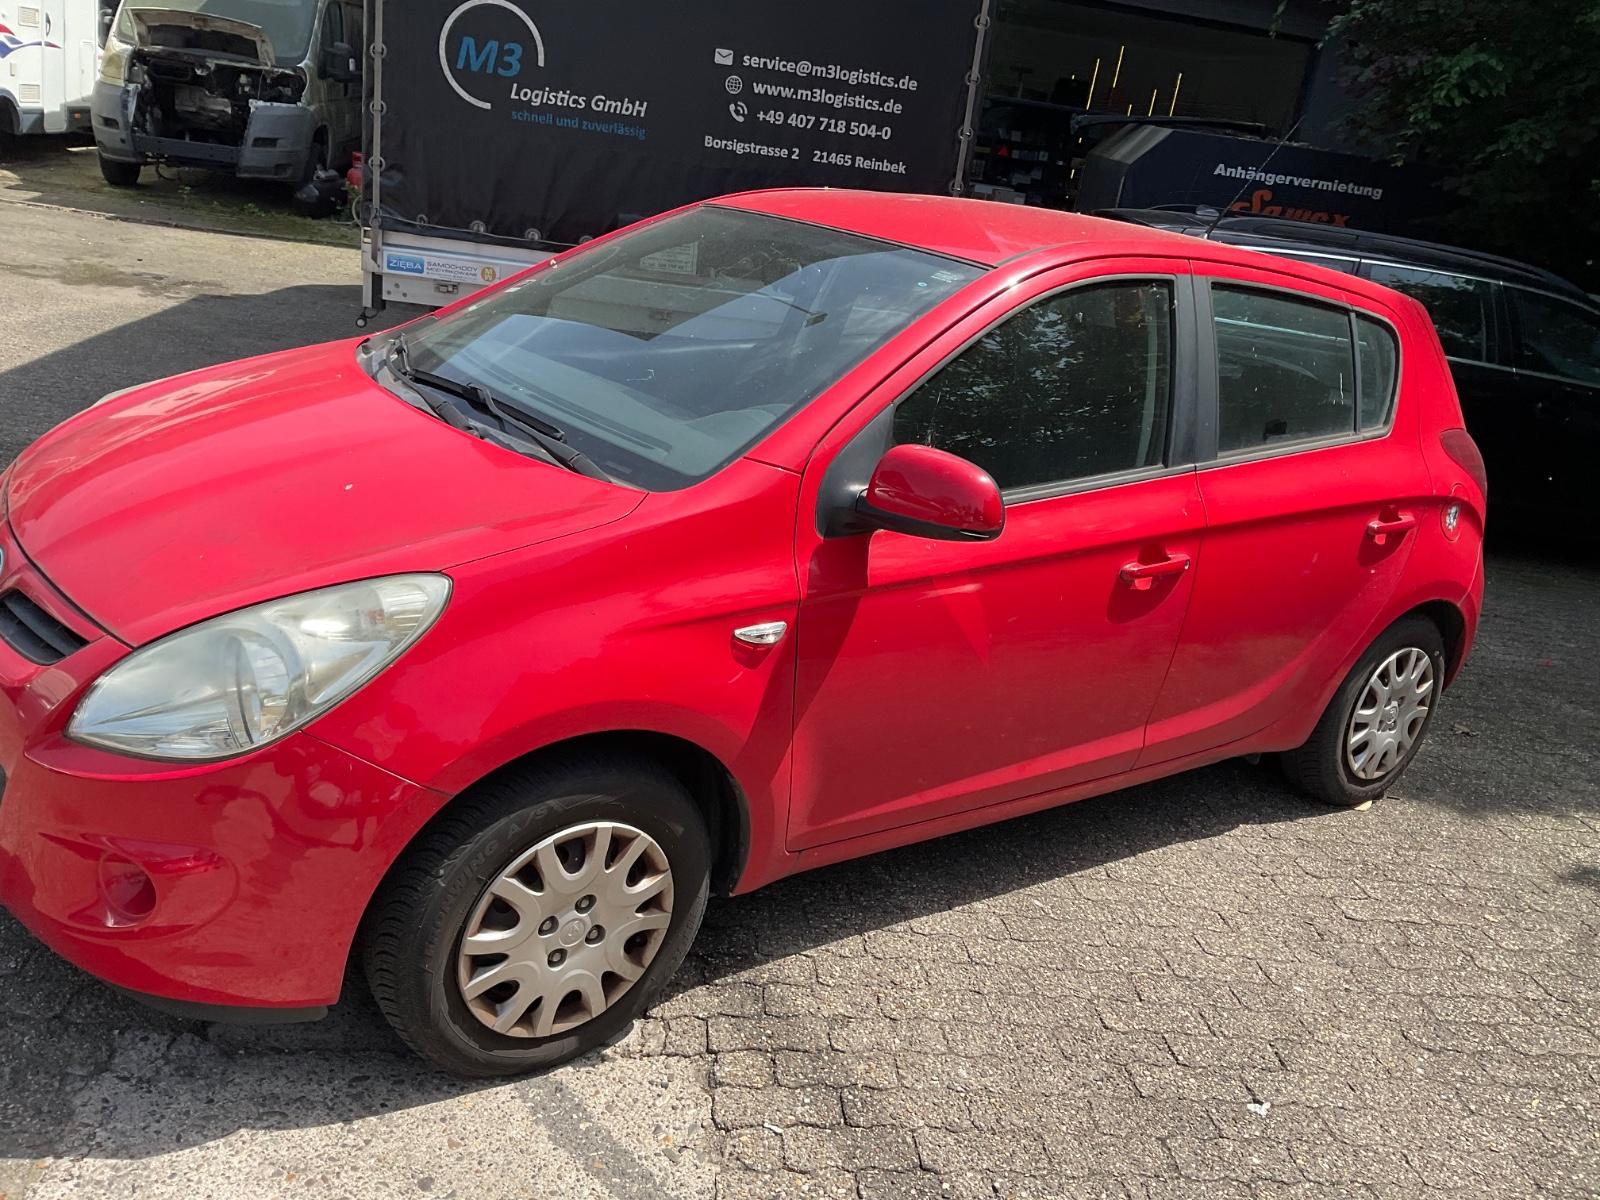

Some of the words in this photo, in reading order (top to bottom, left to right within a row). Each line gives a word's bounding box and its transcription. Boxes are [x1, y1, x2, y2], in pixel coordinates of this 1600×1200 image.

[456, 36, 523, 77] M3
[743, 55, 918, 91] service@m3logistics.de
[510, 83, 587, 109] Logistics
[590, 95, 648, 118] GmbH
[753, 81, 903, 114] www.m3logistics.de
[511, 109, 553, 125] schnell
[556, 116, 579, 129] und
[582, 120, 646, 141] zuverlässig
[757, 110, 784, 125] +49
[787, 113, 816, 129] 407
[819, 117, 847, 134] 718
[849, 122, 892, 140] 504-0
[704, 135, 789, 158] Borsigstrasse
[791, 147, 800, 160] 2
[812, 150, 852, 167] 21465
[854, 156, 907, 174] Reinbek
[1213, 163, 1382, 199] Anhängervermietung
